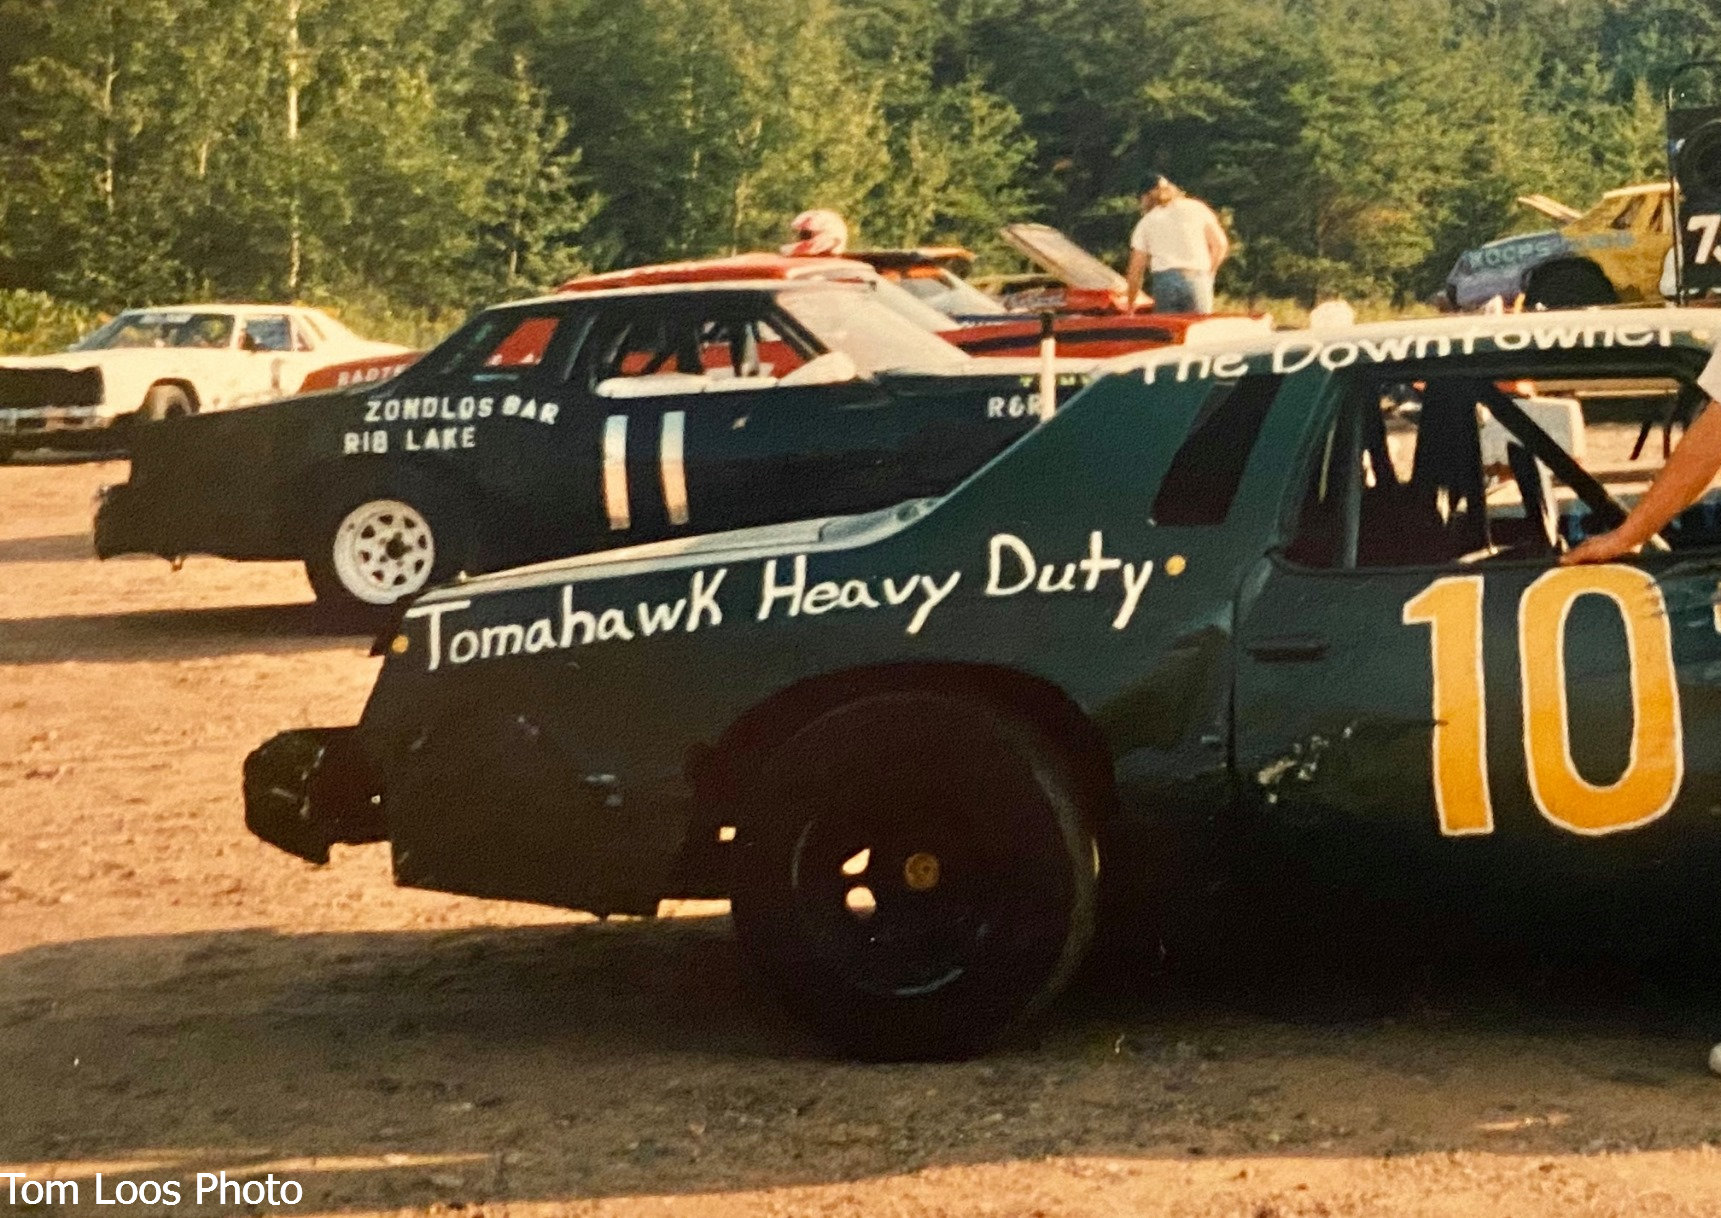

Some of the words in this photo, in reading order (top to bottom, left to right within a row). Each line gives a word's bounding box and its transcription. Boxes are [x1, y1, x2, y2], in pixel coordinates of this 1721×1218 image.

[343, 430, 389, 455] RIB
[404, 426, 477, 451] LAKE
[502, 394, 560, 425] BAR
[603, 410, 690, 531] 11
[757, 554, 962, 634] Heavy
[985, 530, 1154, 630] Duty
[1403, 563, 1685, 837] 10
